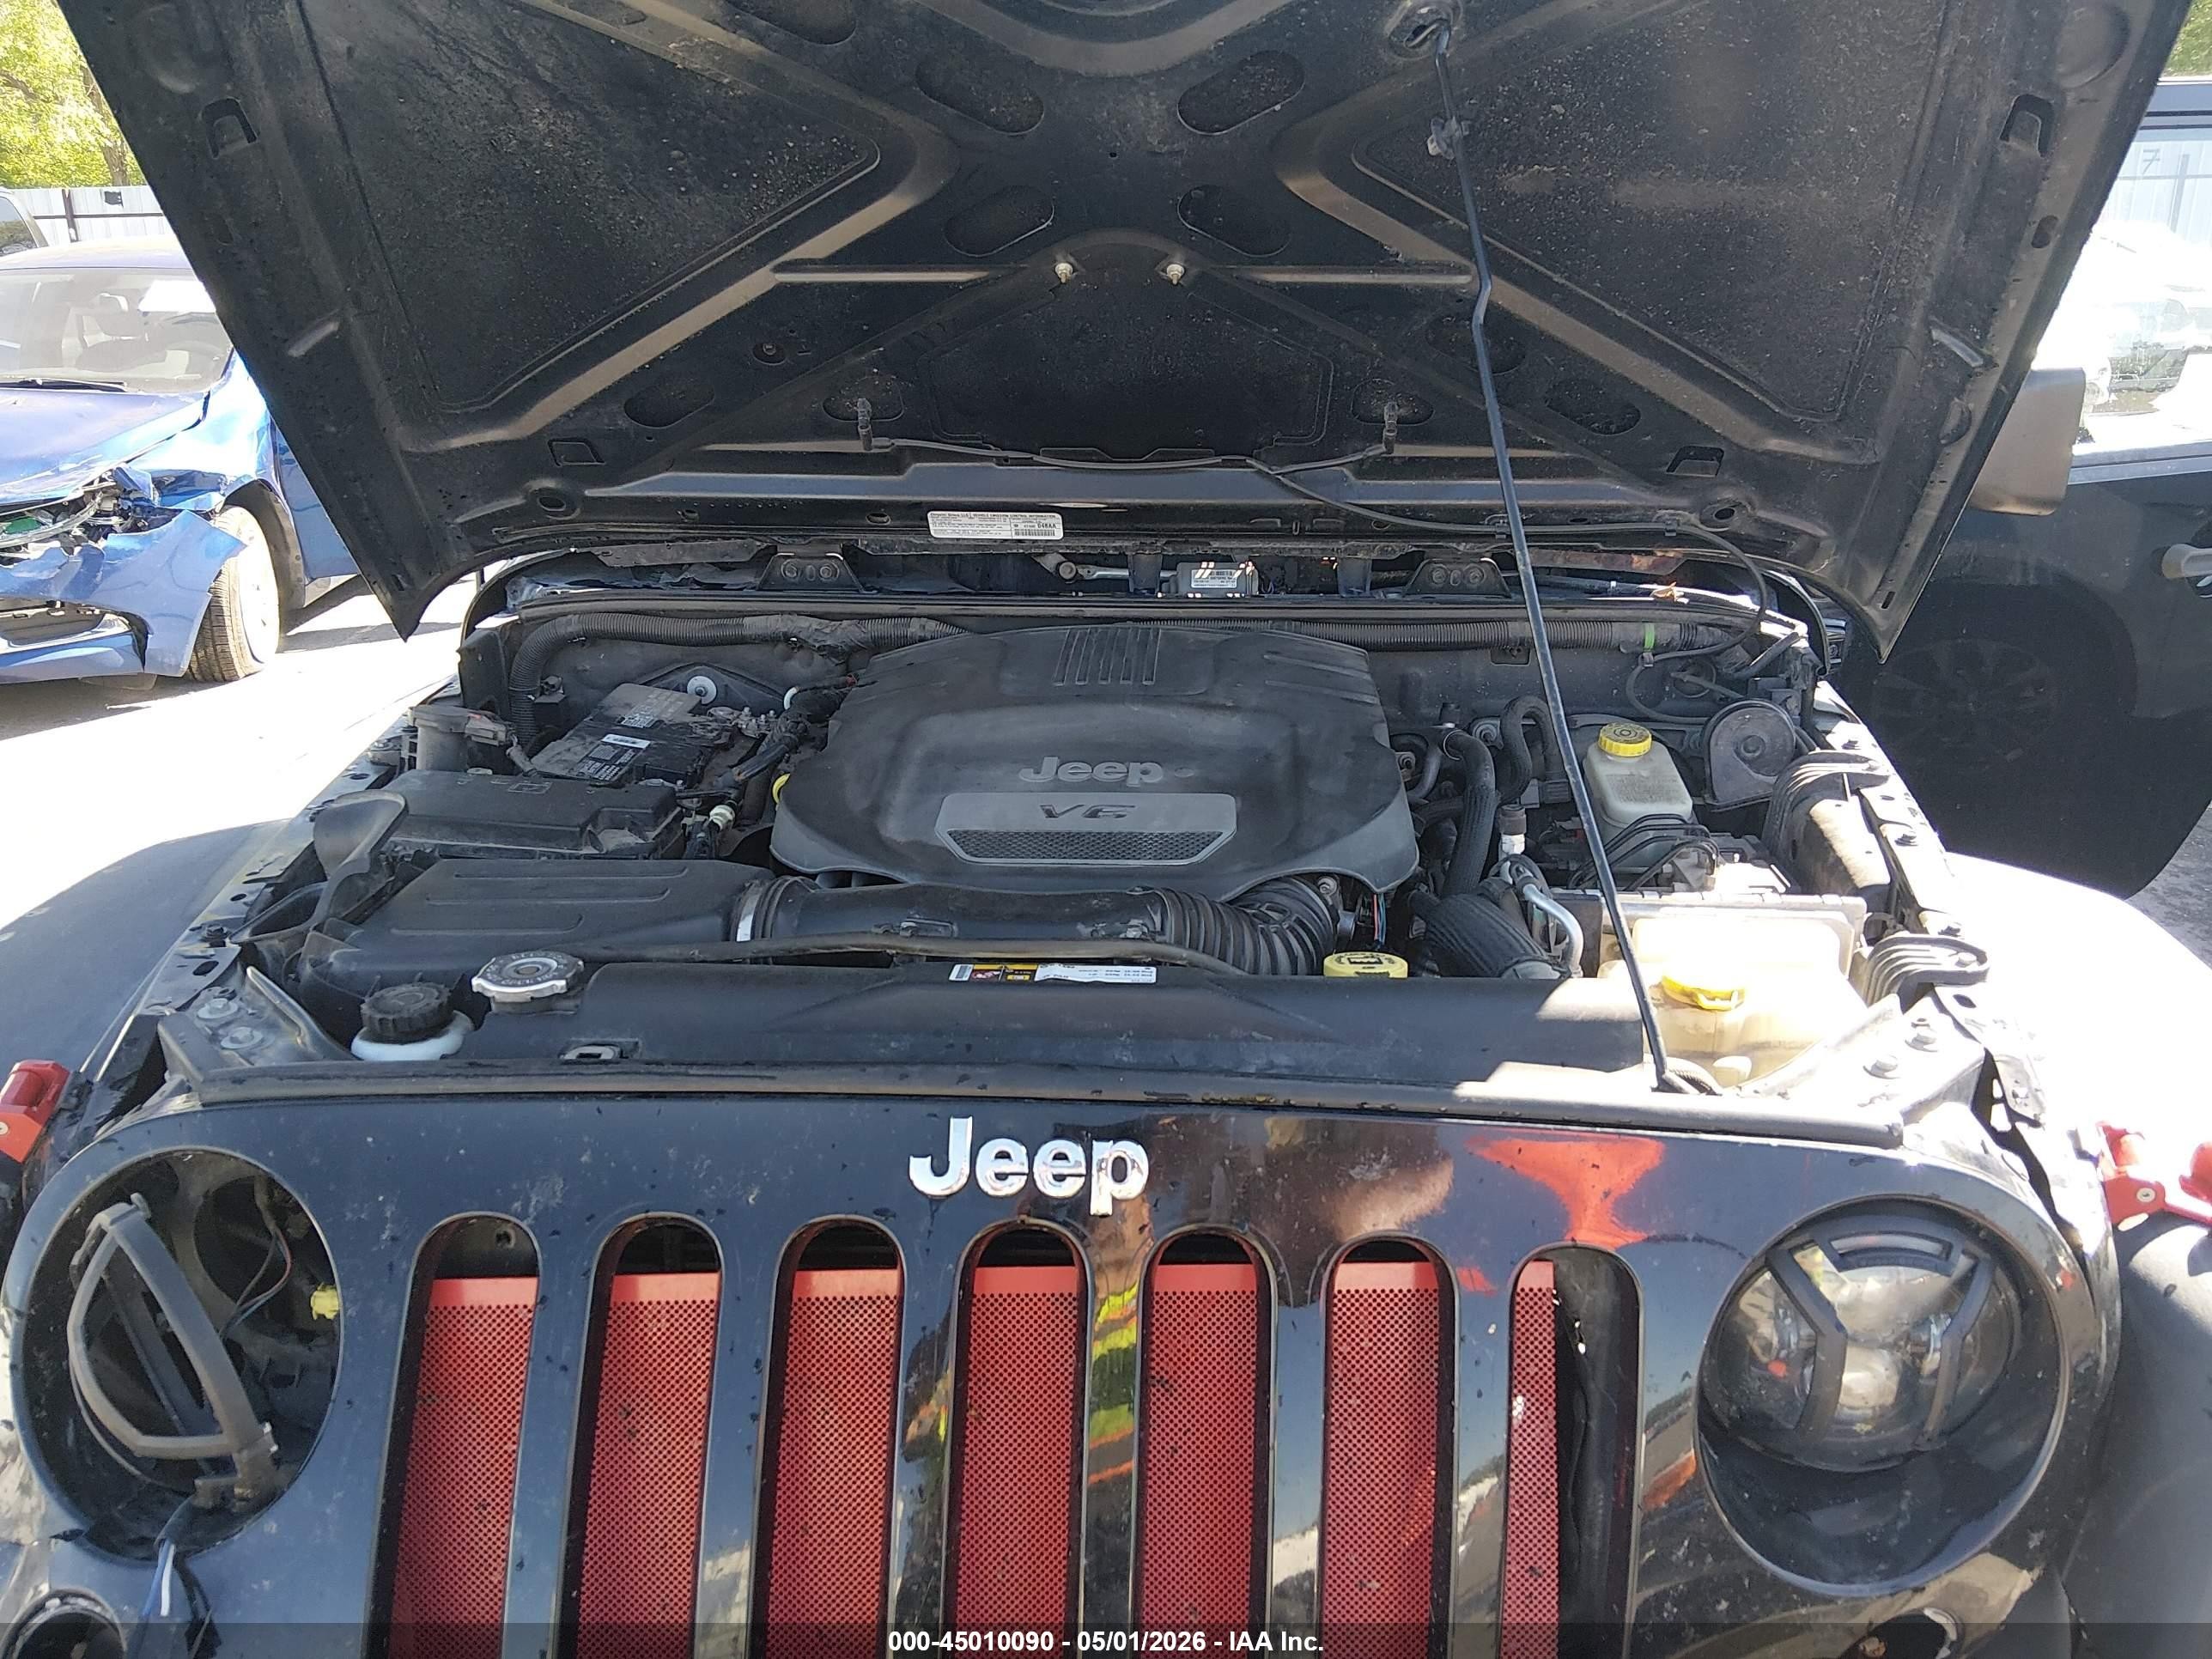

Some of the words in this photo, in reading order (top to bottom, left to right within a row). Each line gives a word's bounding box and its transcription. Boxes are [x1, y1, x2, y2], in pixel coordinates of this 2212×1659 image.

[1018, 756, 1164, 787] Jeep
[1039, 803, 1136, 819] V6
[908, 1115, 1150, 1217] Jeep
